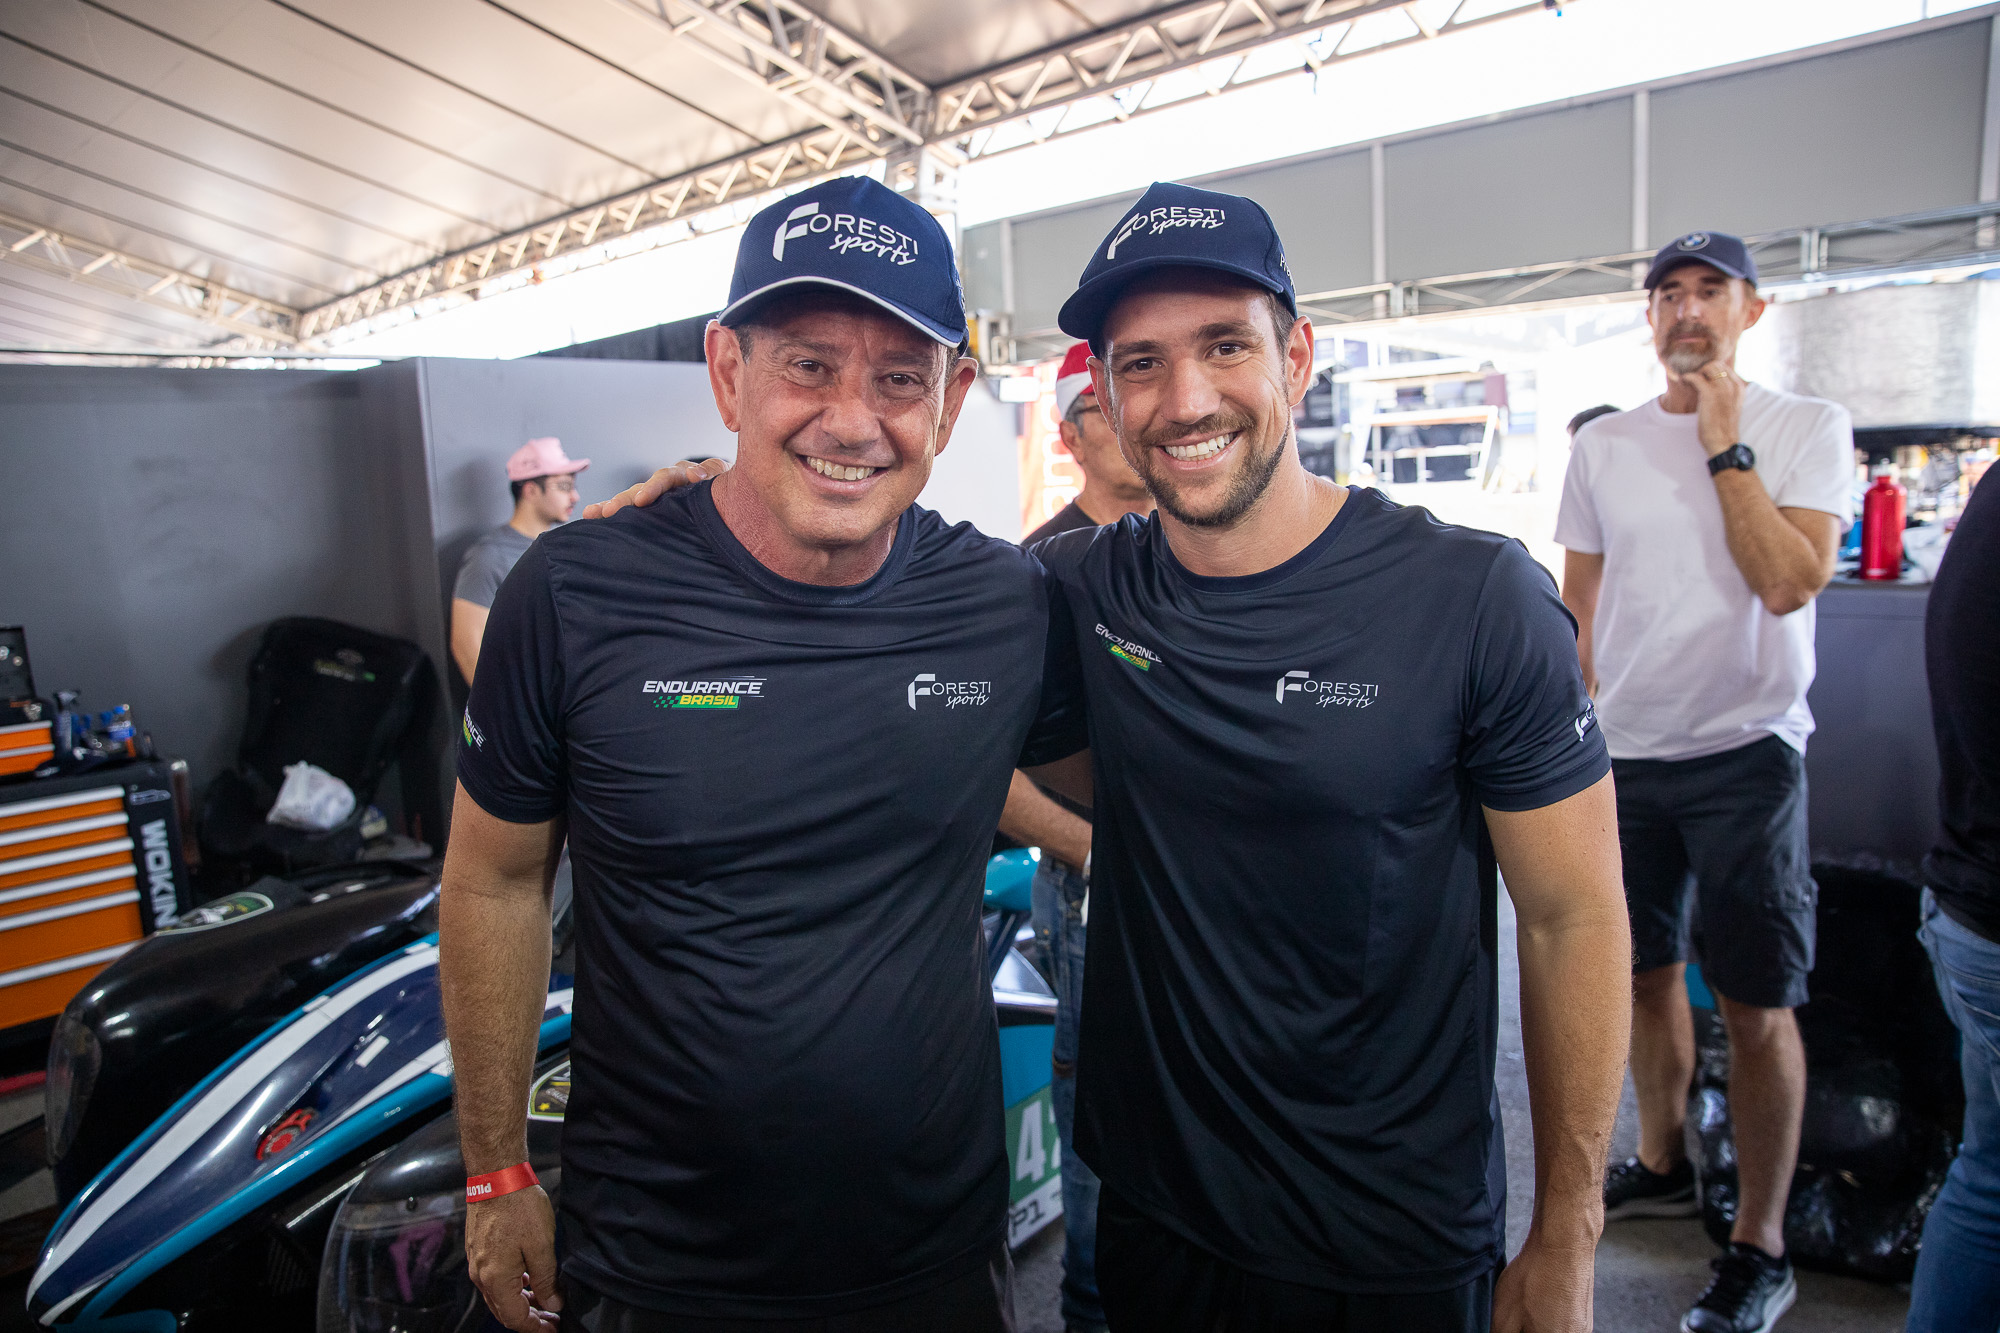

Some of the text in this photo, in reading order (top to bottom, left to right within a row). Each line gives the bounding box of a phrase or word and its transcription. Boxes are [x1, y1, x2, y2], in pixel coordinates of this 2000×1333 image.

[772, 201, 919, 262] FORESTI
[1106, 206, 1226, 260] FORESTI
[1149, 214, 1224, 235] sports
[829, 233, 916, 266] sports
[642, 680, 763, 695] ENDURANCE
[679, 694, 736, 706] BRASIL
[907, 673, 991, 711] FORESTI
[945, 692, 989, 709] sports
[1275, 670, 1379, 705] FORESTI
[1316, 694, 1375, 709] sports
[140, 819, 181, 929] WOKIN
